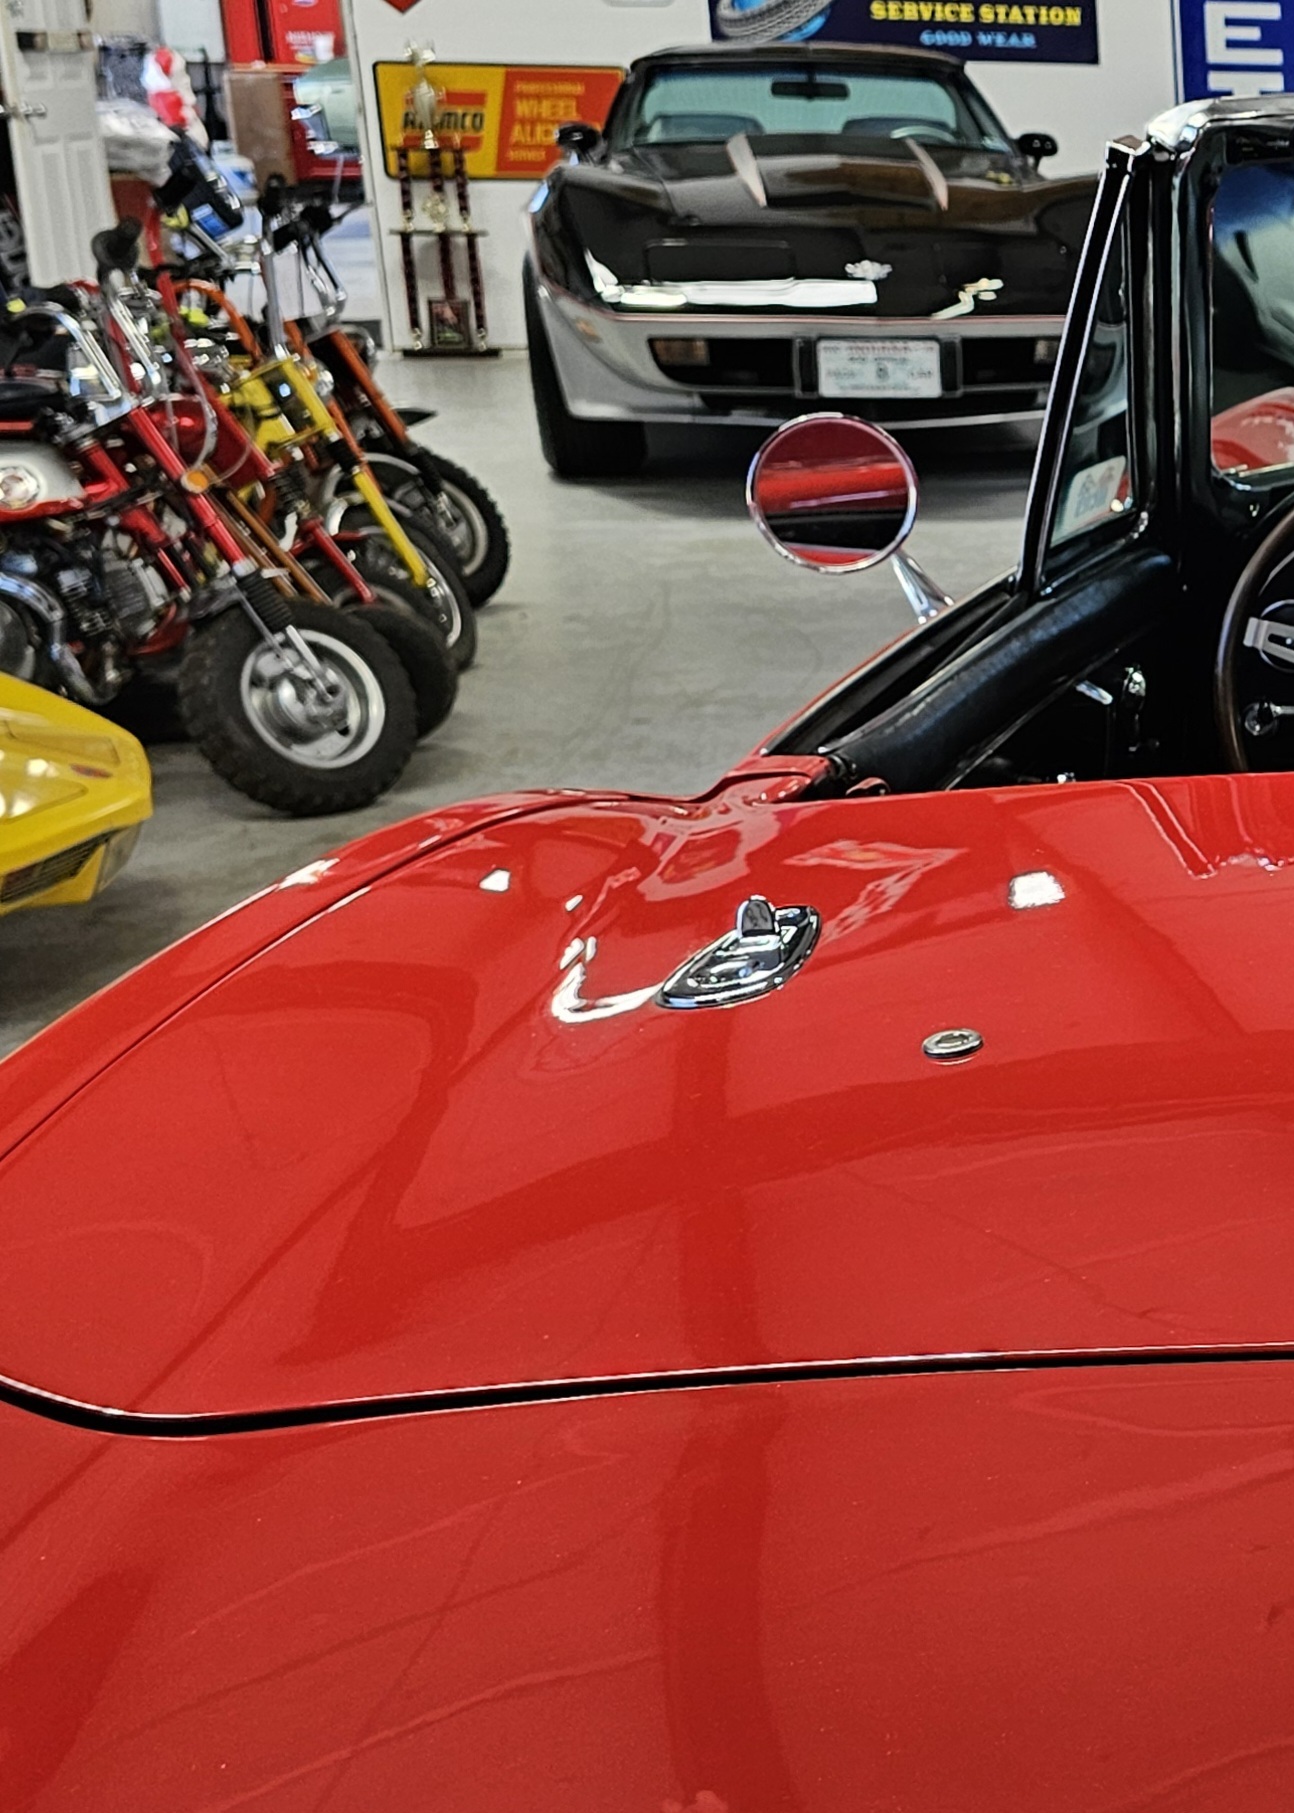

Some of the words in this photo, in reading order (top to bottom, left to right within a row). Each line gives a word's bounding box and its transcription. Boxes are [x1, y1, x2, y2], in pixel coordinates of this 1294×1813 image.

[870, 1, 974, 22] SERVICE
[979, 6, 1081, 25] STATION
[515, 98, 581, 118] WHEEL
